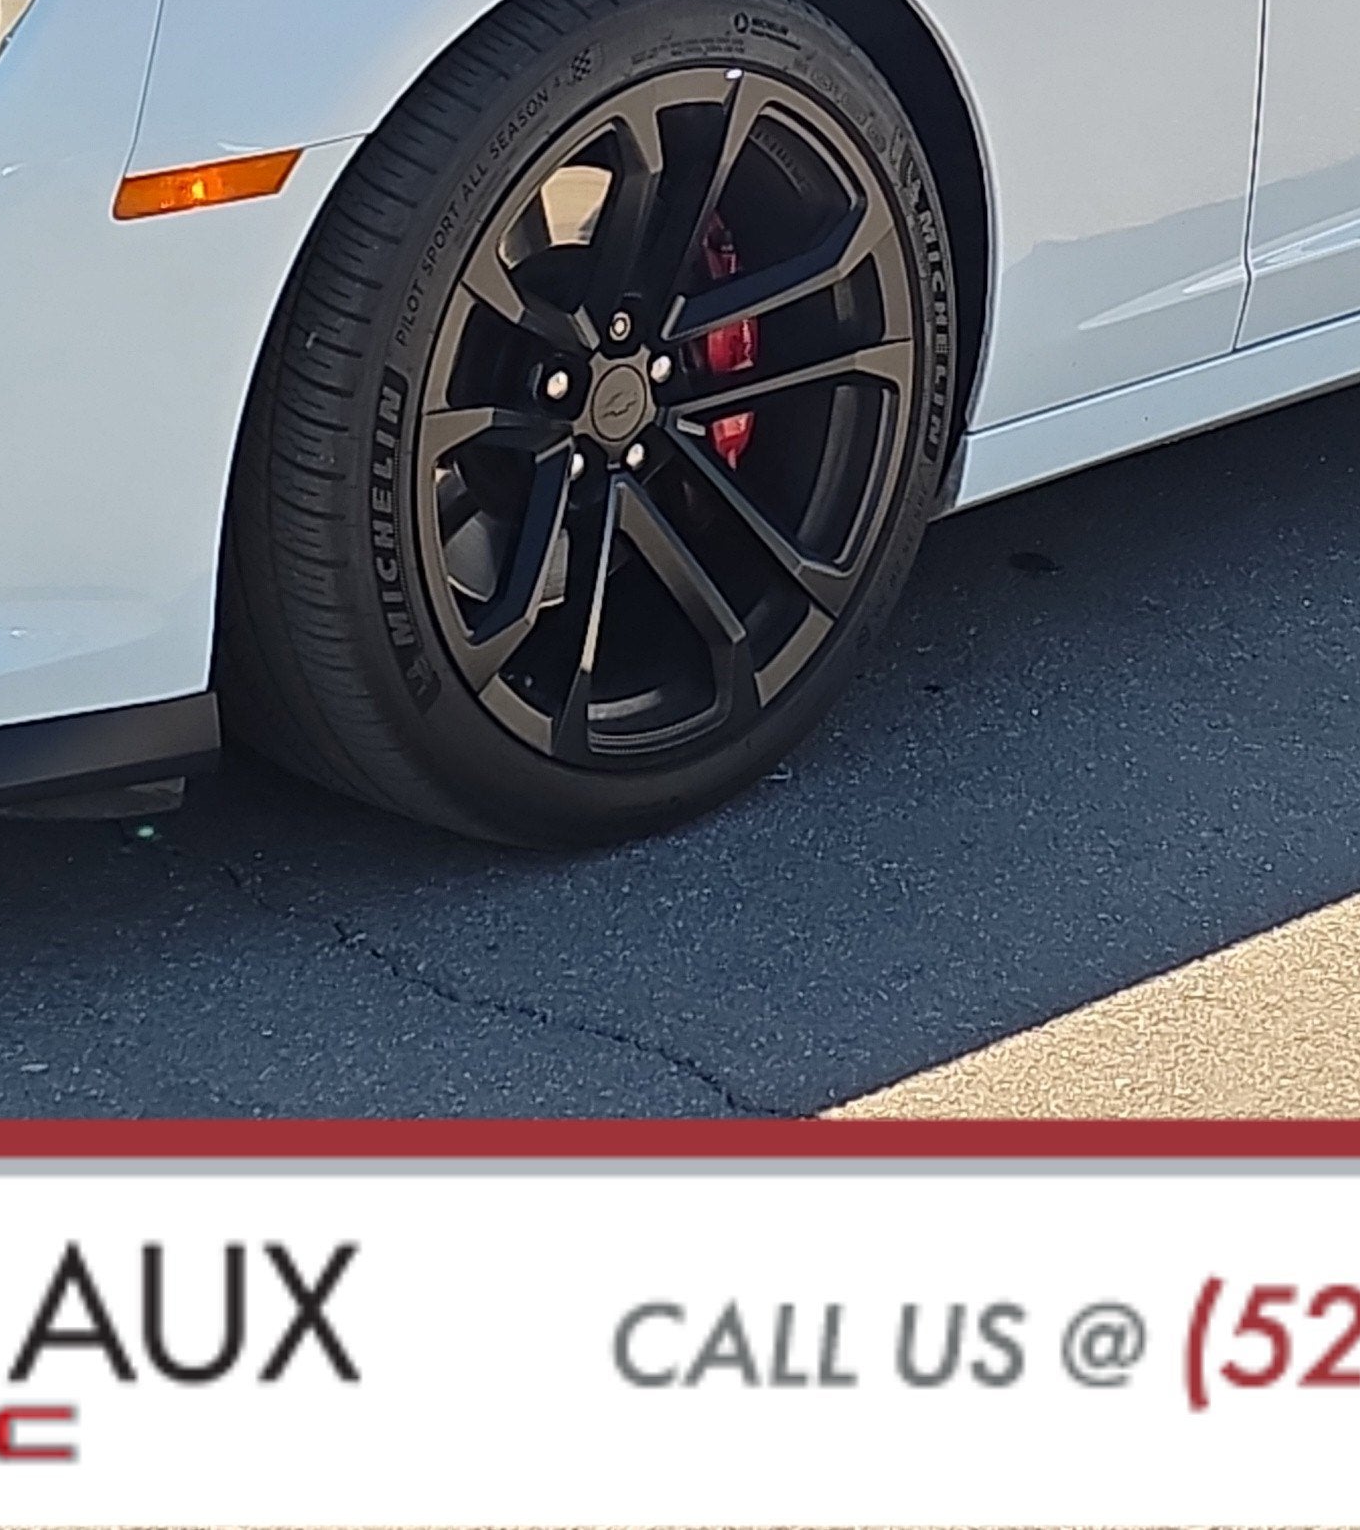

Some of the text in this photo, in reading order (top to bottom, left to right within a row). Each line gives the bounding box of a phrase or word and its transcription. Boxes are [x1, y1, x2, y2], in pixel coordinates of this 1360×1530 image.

[395, 278, 427, 348] PILOT
[421, 203, 461, 277] SPORT
[460, 165, 490, 203] ALL
[489, 87, 550, 160] SEASON
[919, 208, 949, 447] MICHELIN
[371, 385, 416, 648] MICHELIN
